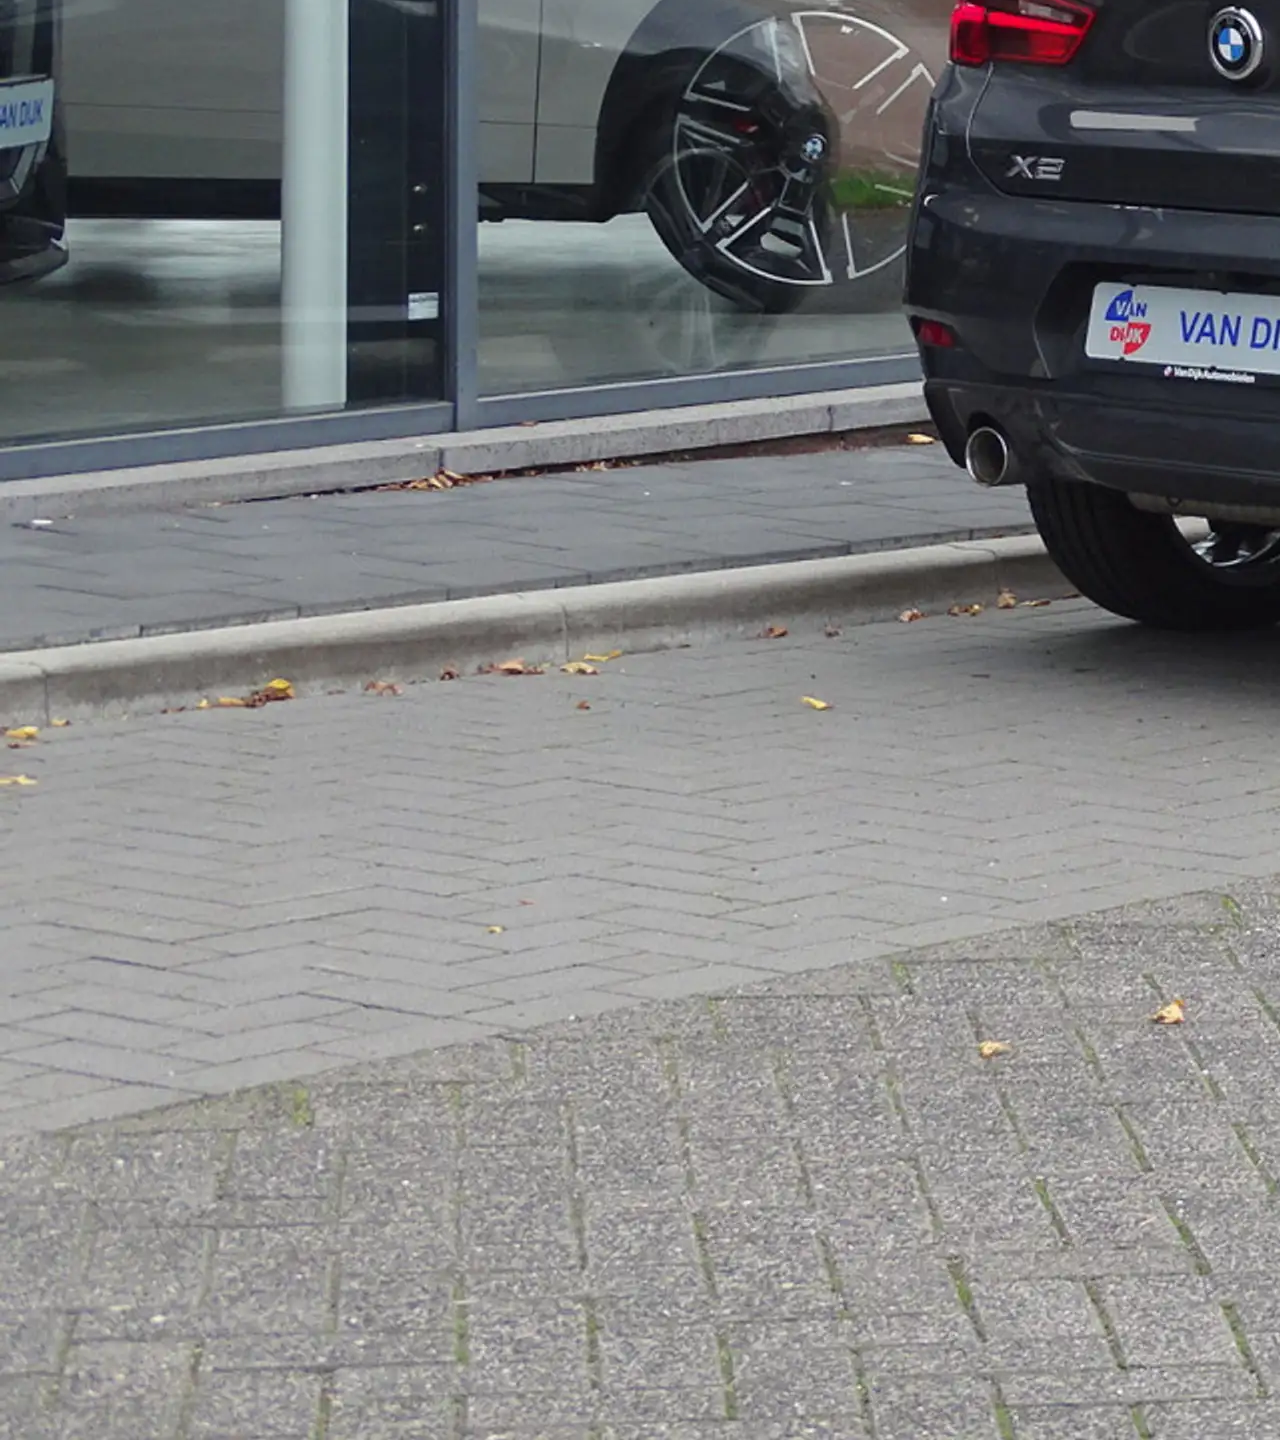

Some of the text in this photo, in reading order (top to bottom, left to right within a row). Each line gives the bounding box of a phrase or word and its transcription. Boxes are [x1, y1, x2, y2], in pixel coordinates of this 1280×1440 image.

[1005, 154, 1066, 182] X2
[1115, 300, 1148, 318] VAN
[1180, 310, 1242, 347] VAN
